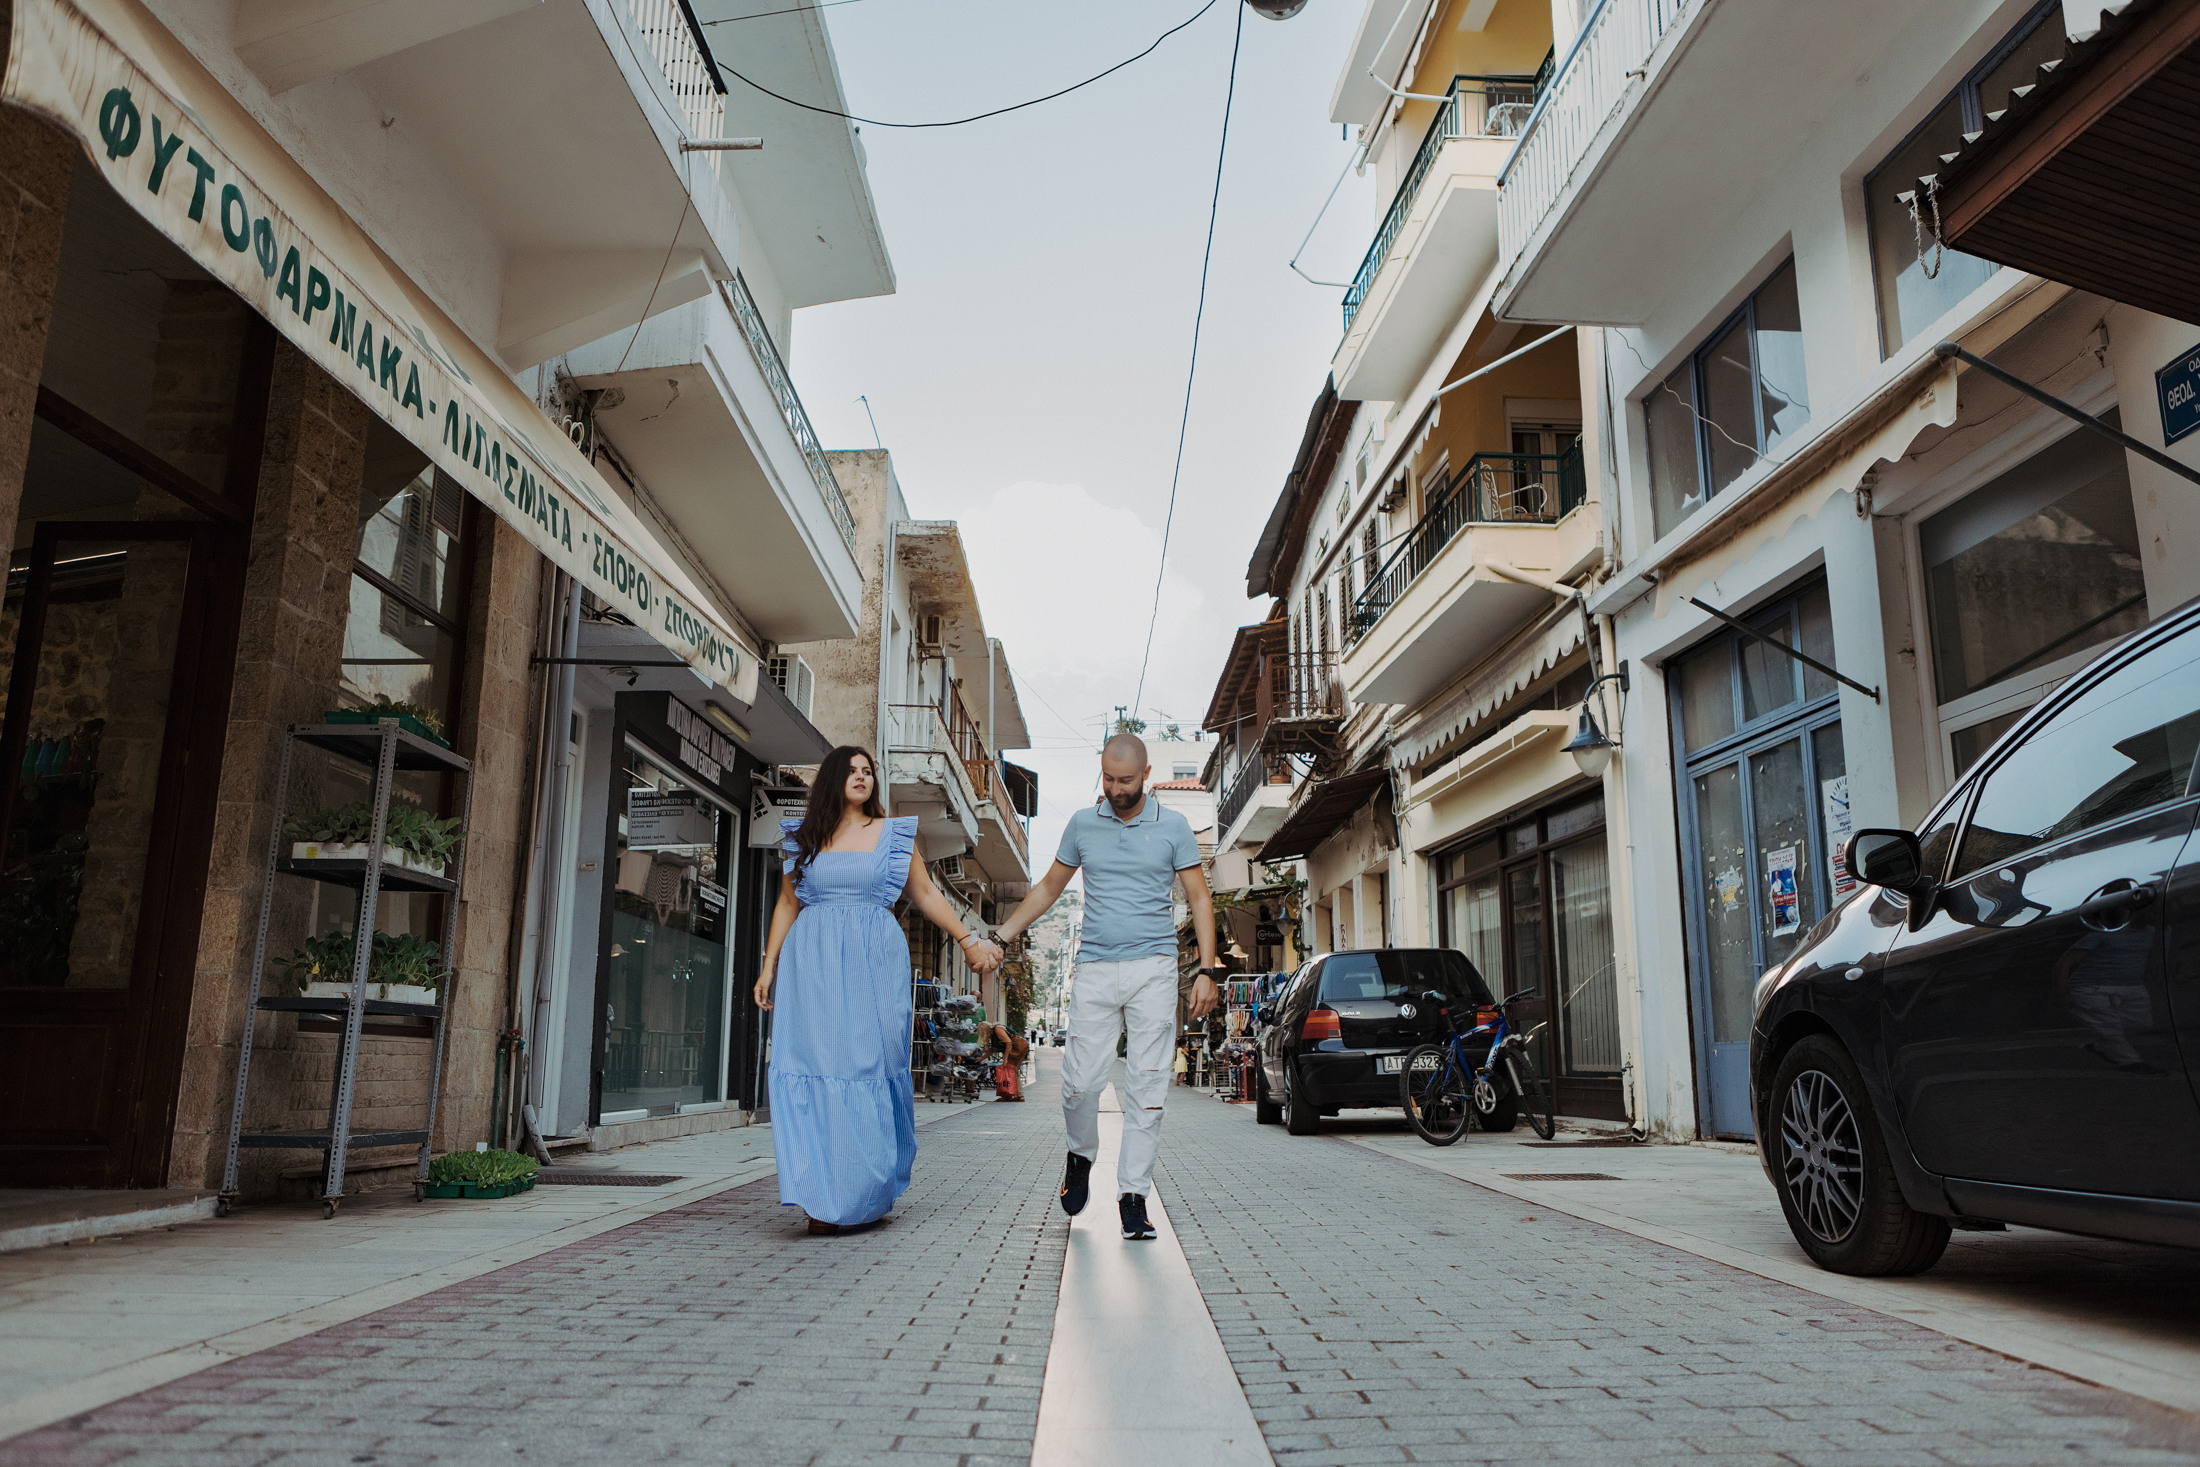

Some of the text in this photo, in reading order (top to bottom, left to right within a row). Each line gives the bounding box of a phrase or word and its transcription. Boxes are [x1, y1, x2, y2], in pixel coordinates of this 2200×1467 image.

[99, 86, 425, 419] ΦΥΤΟΦΑΡΜΑΚΑ
[442, 399, 573, 554] ΛΙΠΑΣΜΑΤΑ
[592, 531, 652, 616] ΣΠΟΡΟΙ
[664, 595, 740, 684] ΣΠΟΡΟΦΥΤΑ
[2167, 379, 2196, 410] ΘΕΟΔ.
